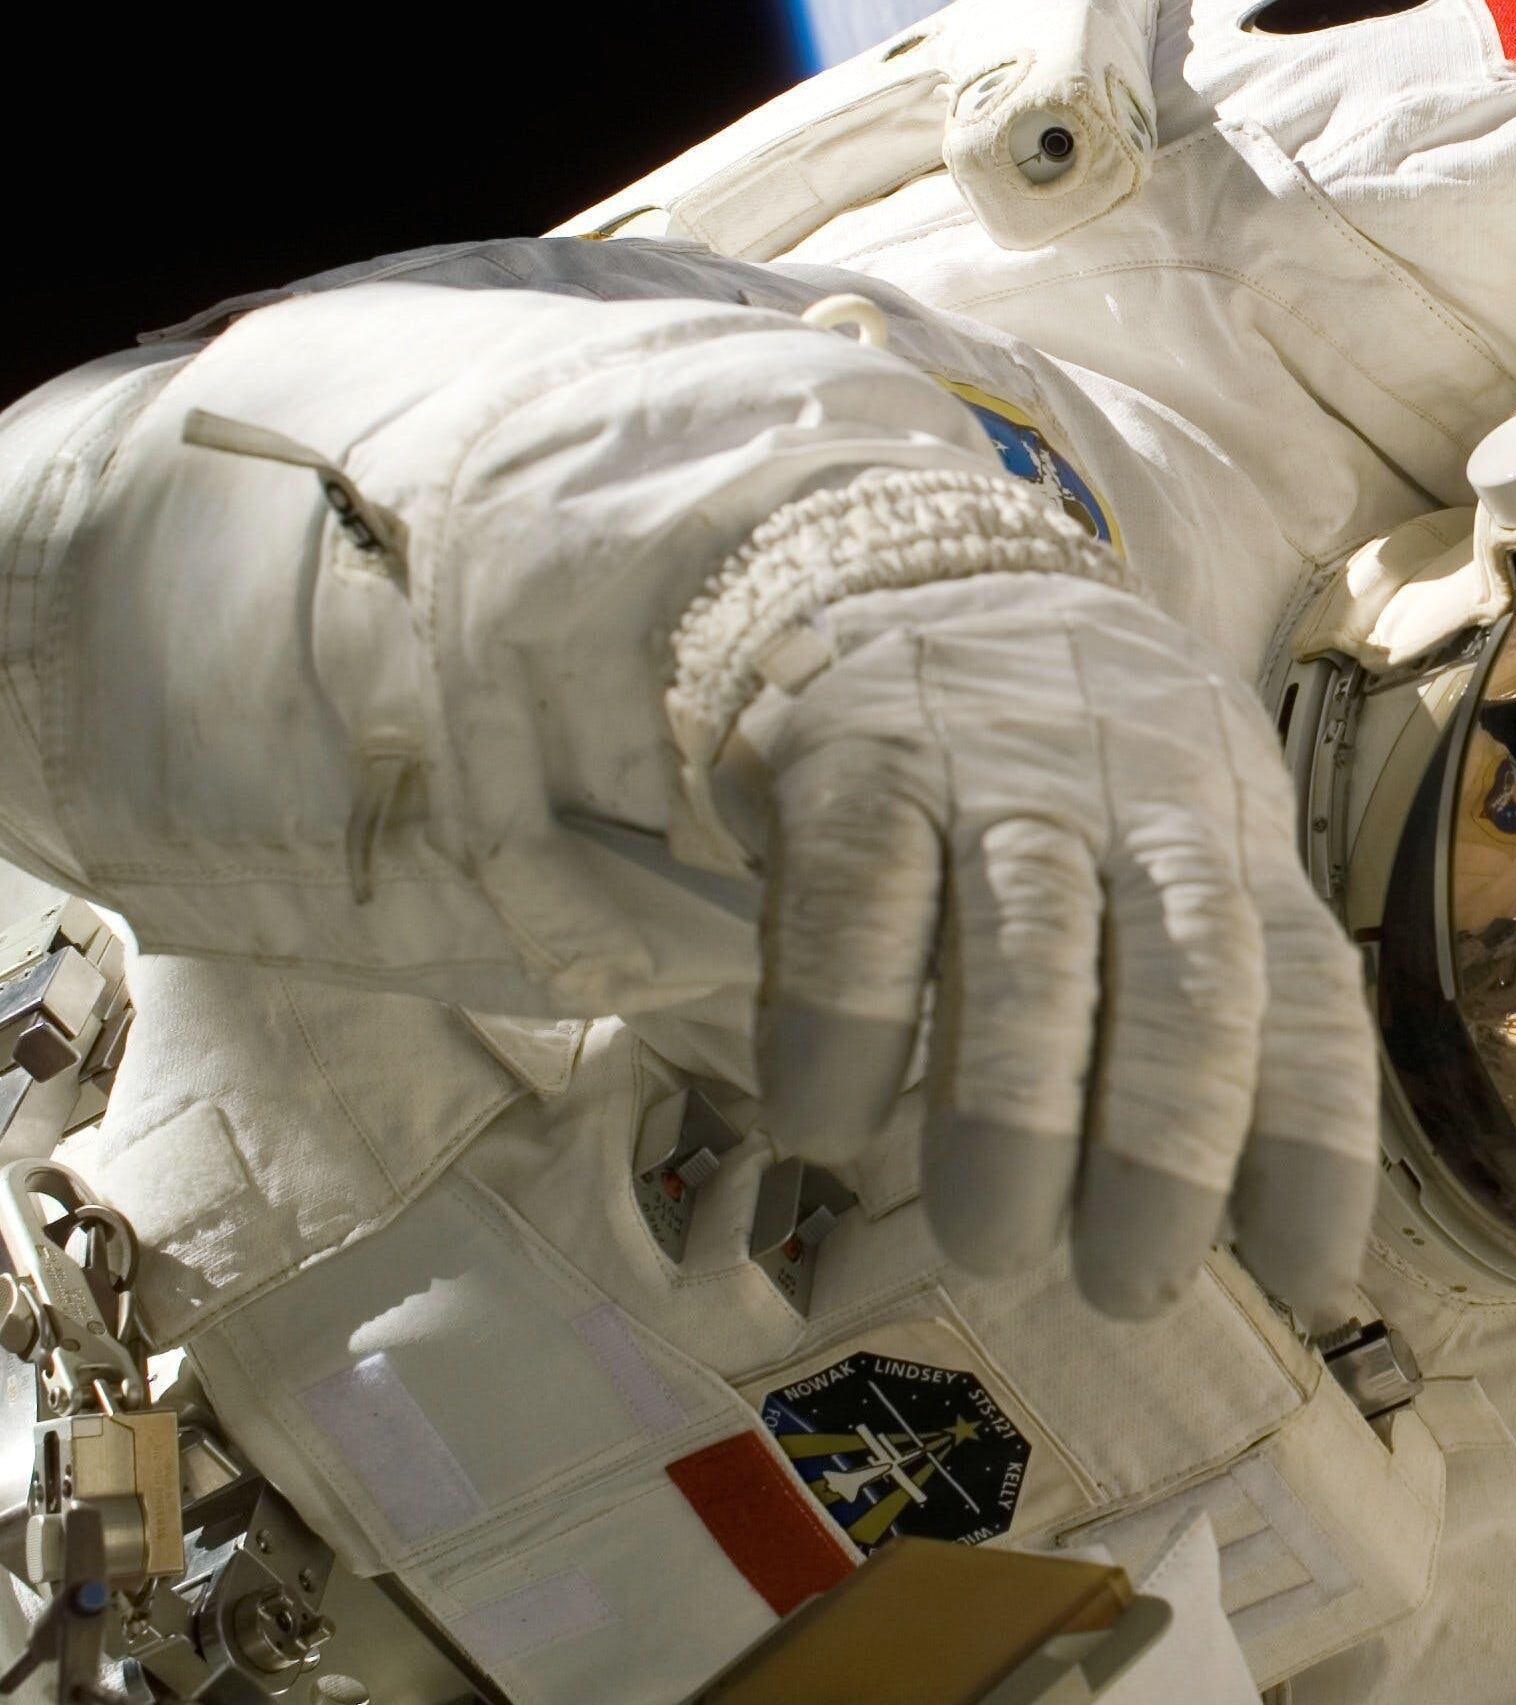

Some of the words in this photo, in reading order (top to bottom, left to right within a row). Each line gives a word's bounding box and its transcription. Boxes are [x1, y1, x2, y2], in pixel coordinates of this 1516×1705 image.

[783, 1361, 856, 1400] NOWAK
[874, 1358, 959, 1384] LINDSEY
[968, 1389, 1017, 1440] STS-121
[998, 1461, 1023, 1509] KELLY
[952, 1527, 993, 1546] WIL
